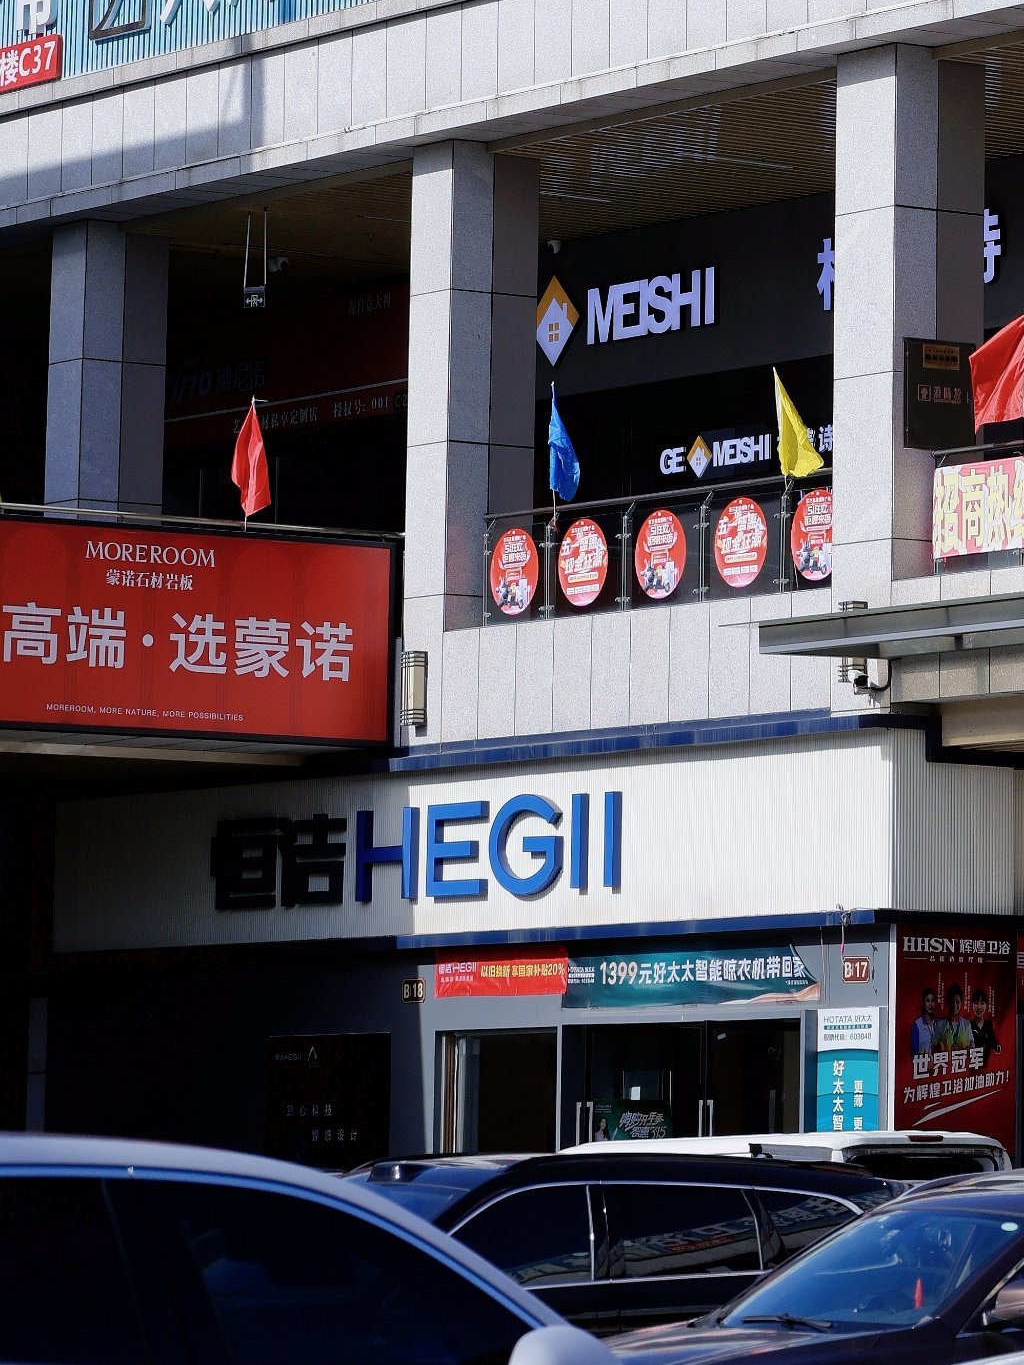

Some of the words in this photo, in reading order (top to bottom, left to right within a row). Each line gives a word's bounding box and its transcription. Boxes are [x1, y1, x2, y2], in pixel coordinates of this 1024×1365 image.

[587, 267, 716, 345] MEISHI
[660, 446, 686, 475] GE
[713, 434, 772, 467] MEISHI
[85, 540, 216, 567] MOREROOM
[106, 568, 194, 591] 蒙诺石材岩板
[99, 706, 123, 715] MORE
[162, 710, 186, 718] MORE
[188, 711, 244, 721] POSSIBILITIES
[902, 937, 955, 953] HHSN
[960, 939, 1011, 955] 辉煌卫浴
[480, 964, 510, 978] 以旧换新
[824, 1015, 852, 1024] HOTATA
[912, 1047, 984, 1080] 世界冠军
[832, 1060, 845, 1131] 好太太智
[904, 1070, 1010, 1104] 为辉煌卫浴加油助力!
